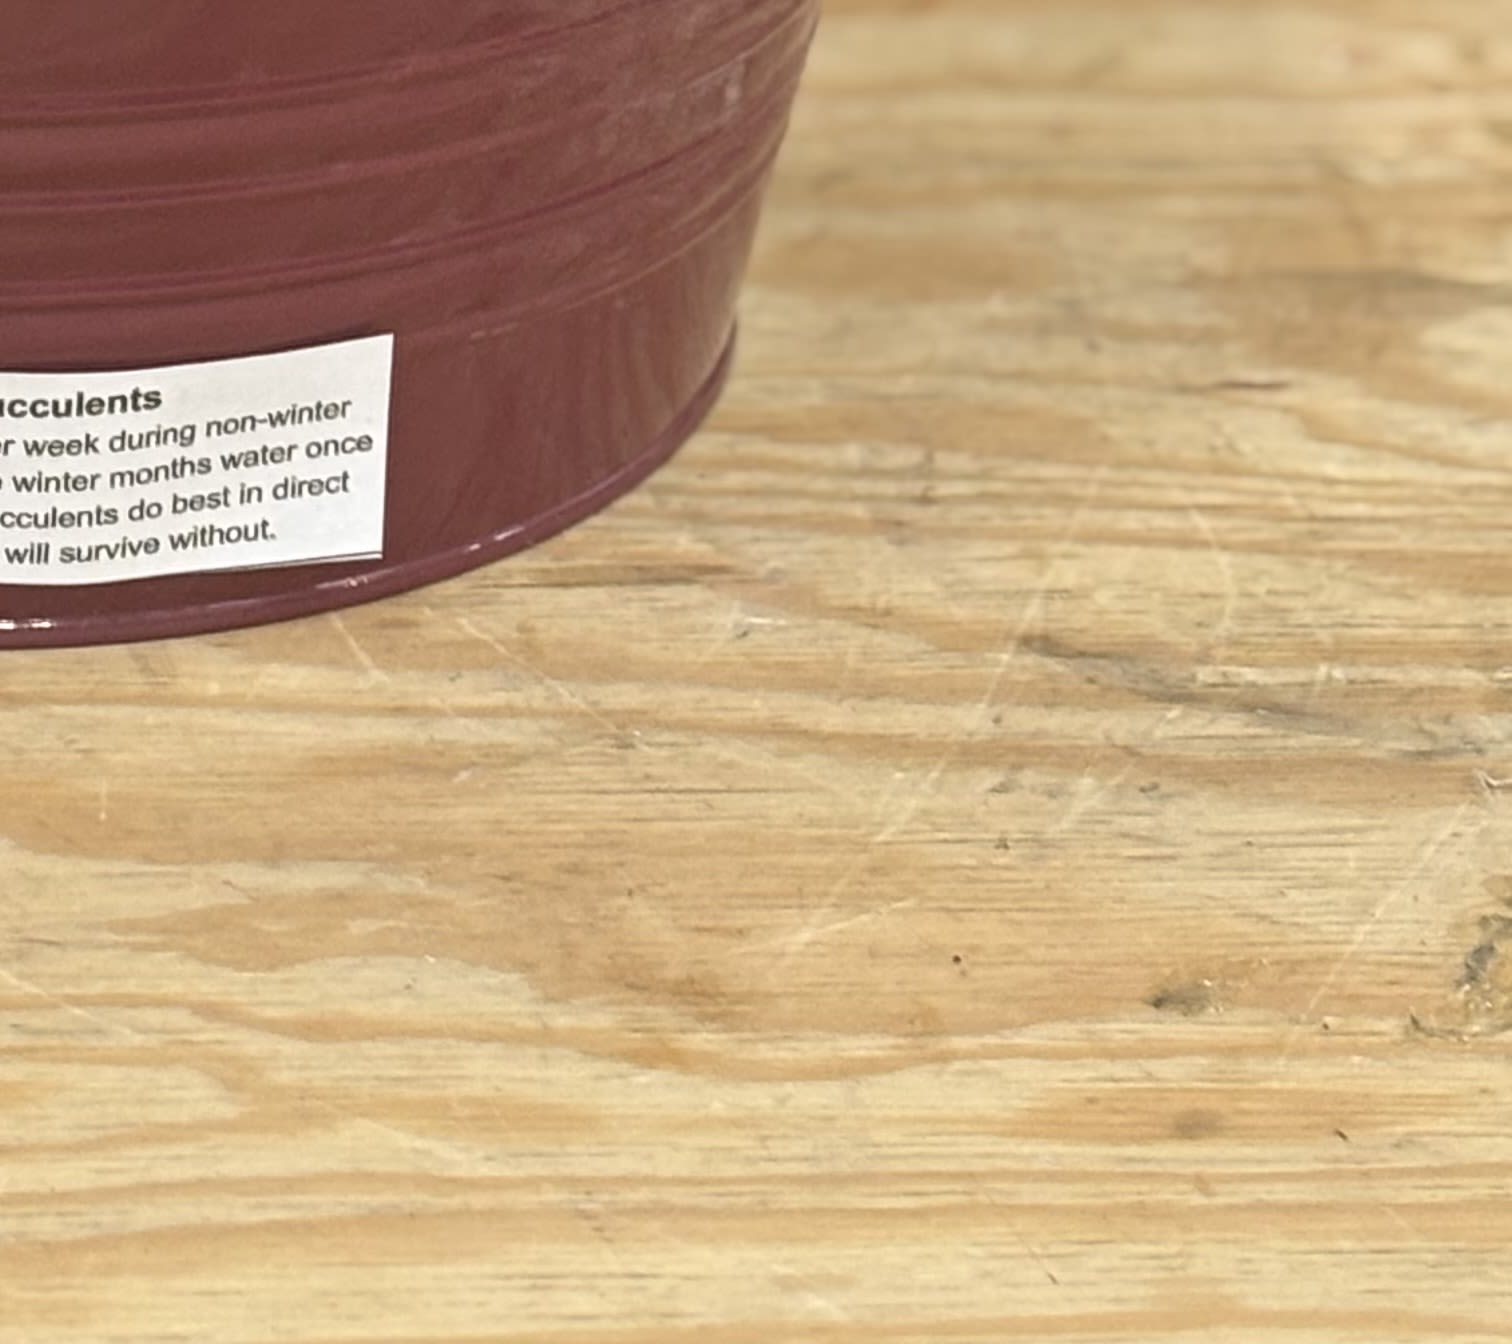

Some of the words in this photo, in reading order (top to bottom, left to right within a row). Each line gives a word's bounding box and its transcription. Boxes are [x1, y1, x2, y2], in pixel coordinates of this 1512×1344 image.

[23, 433, 99, 457] week
[109, 424, 196, 453] during
[206, 400, 351, 437] non-winter
[12, 471, 100, 493] winter
[110, 457, 212, 488] months
[220, 445, 297, 470] water
[305, 435, 373, 458] once
[128, 499, 163, 521] do
[172, 487, 229, 514] best
[239, 486, 263, 504] in
[272, 471, 349, 500] direct
[4, 542, 50, 564] will
[60, 538, 160, 563] survive
[169, 519, 276, 550] without.
